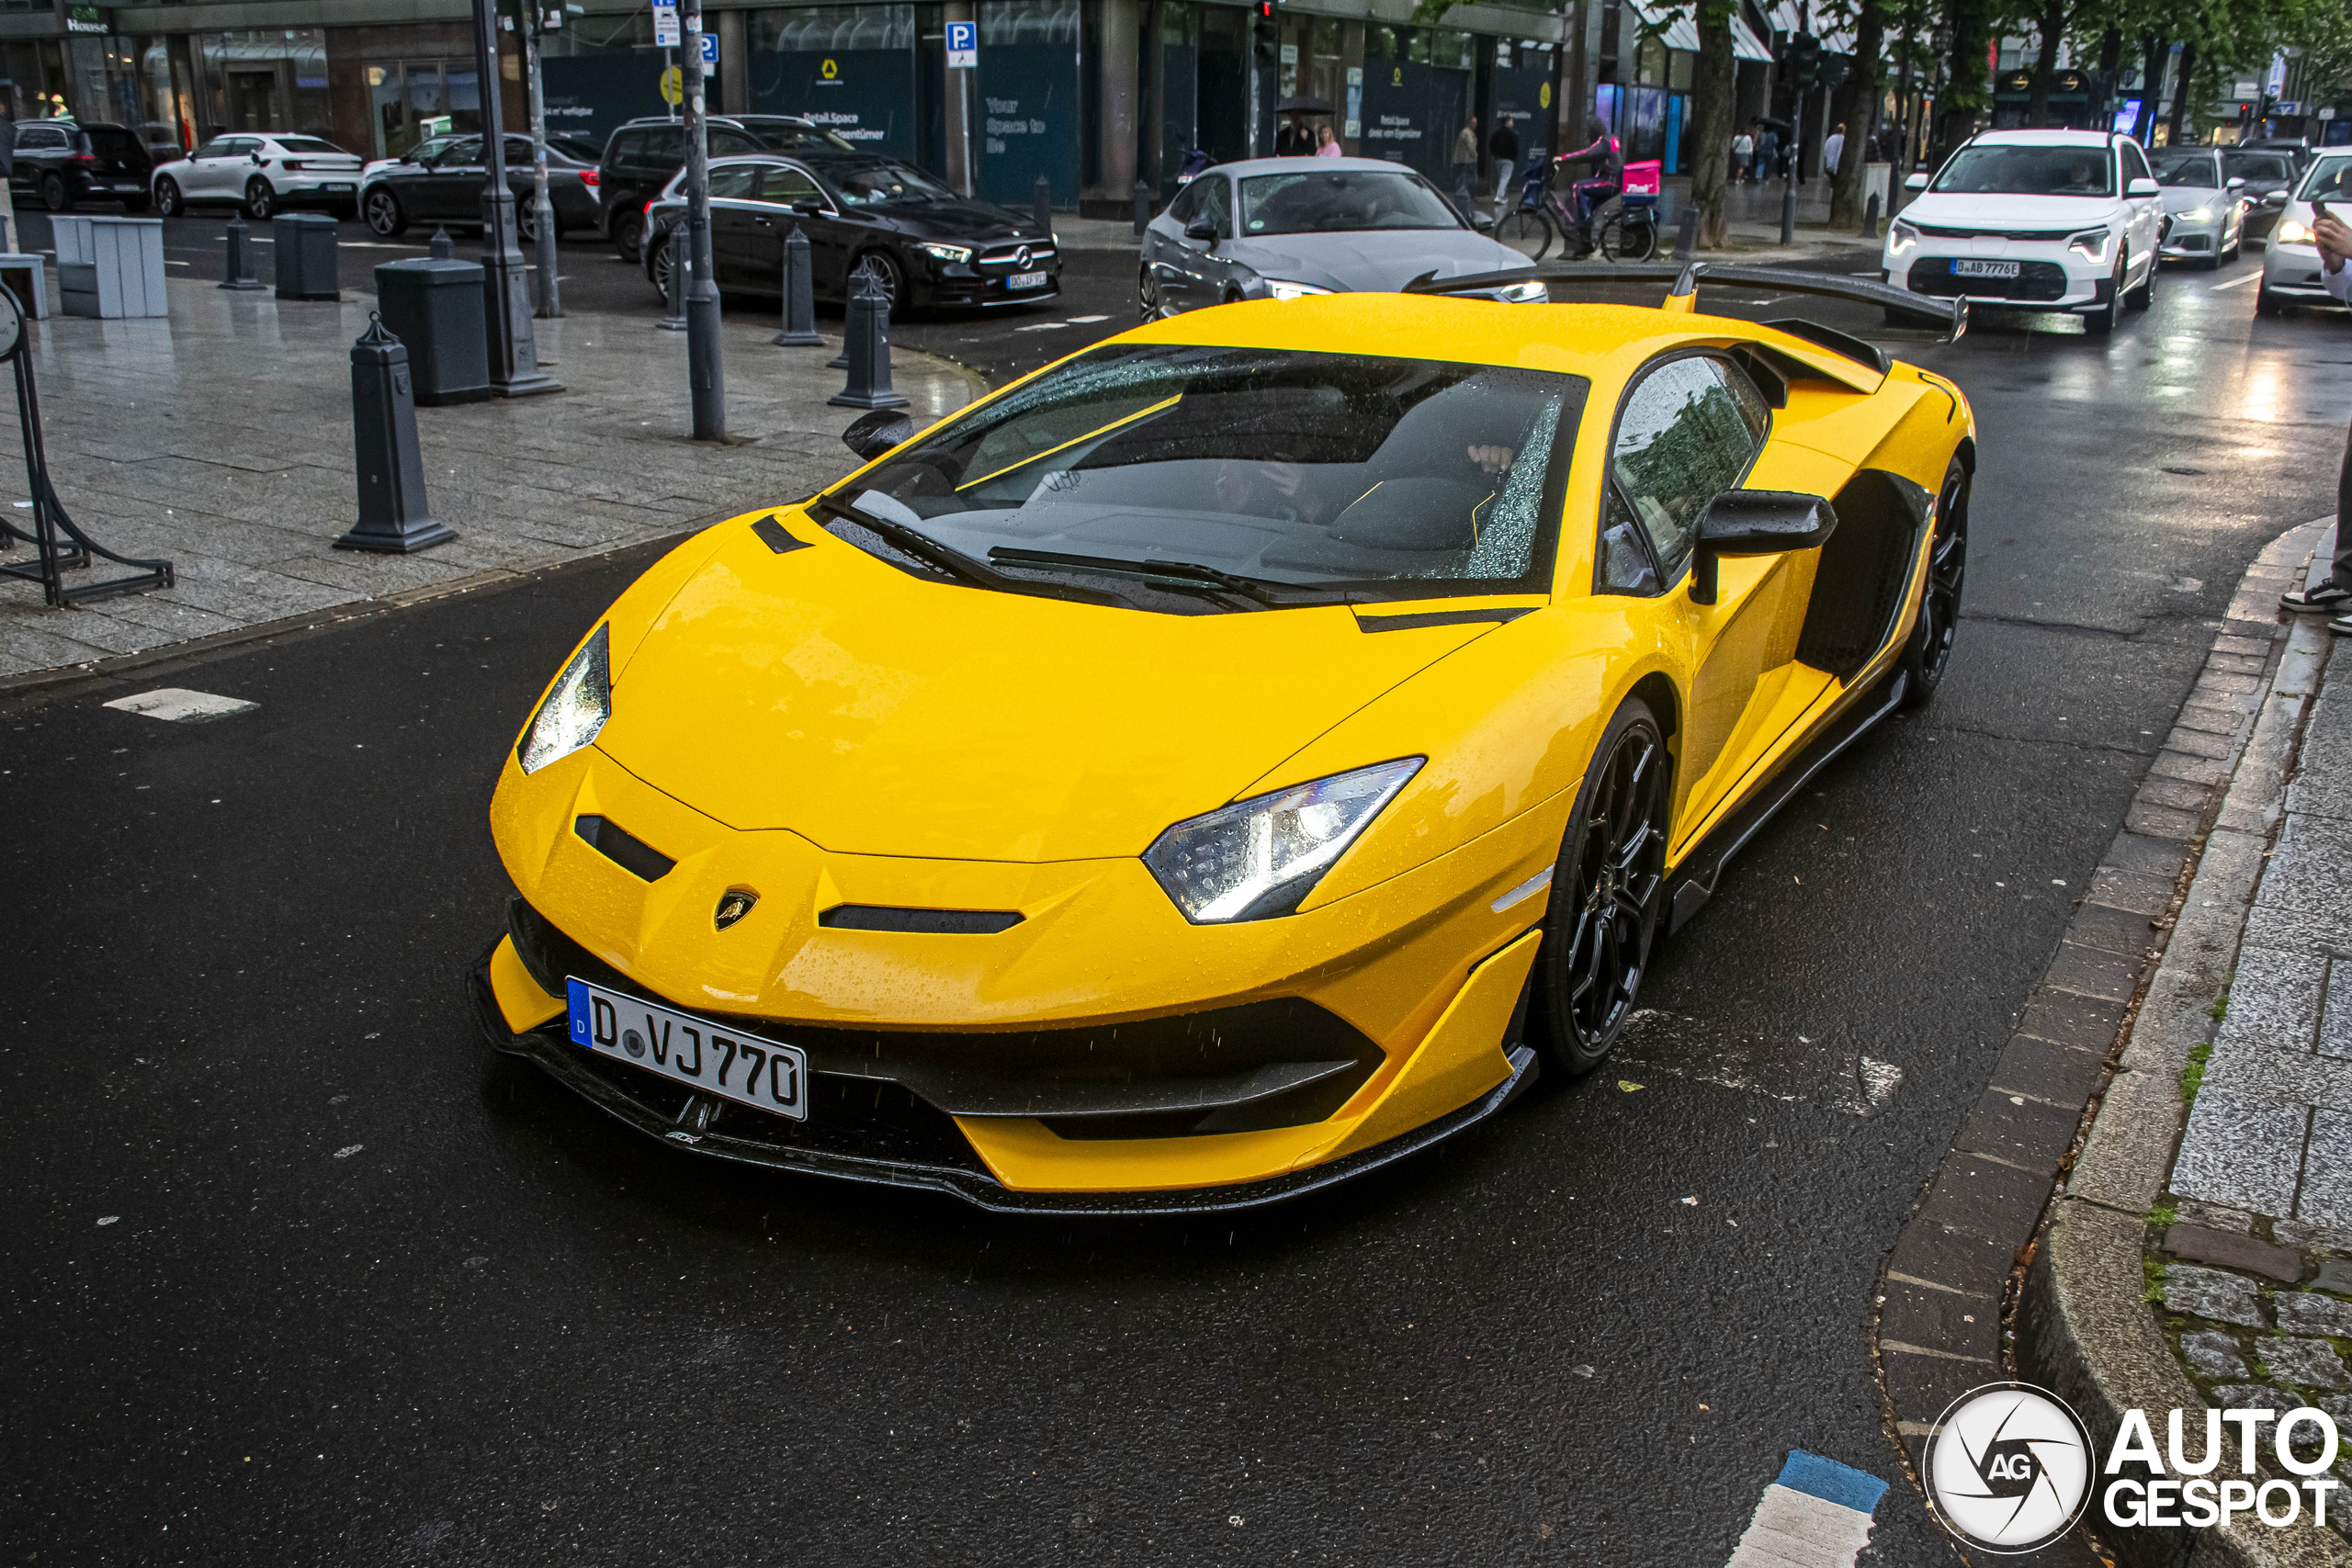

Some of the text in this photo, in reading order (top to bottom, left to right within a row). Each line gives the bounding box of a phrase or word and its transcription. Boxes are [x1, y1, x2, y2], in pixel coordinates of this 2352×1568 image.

[67, 18, 108, 33] House
[953, 26, 969, 49] P
[985, 97, 1019, 113] Your
[831, 112, 858, 125] Space
[987, 118, 1046, 136] Space to
[987, 138, 1006, 153] Be
[1971, 262, 1983, 273] AB
[1985, 264, 2018, 275] 7776E
[592, 995, 798, 1107] D VJ 770
